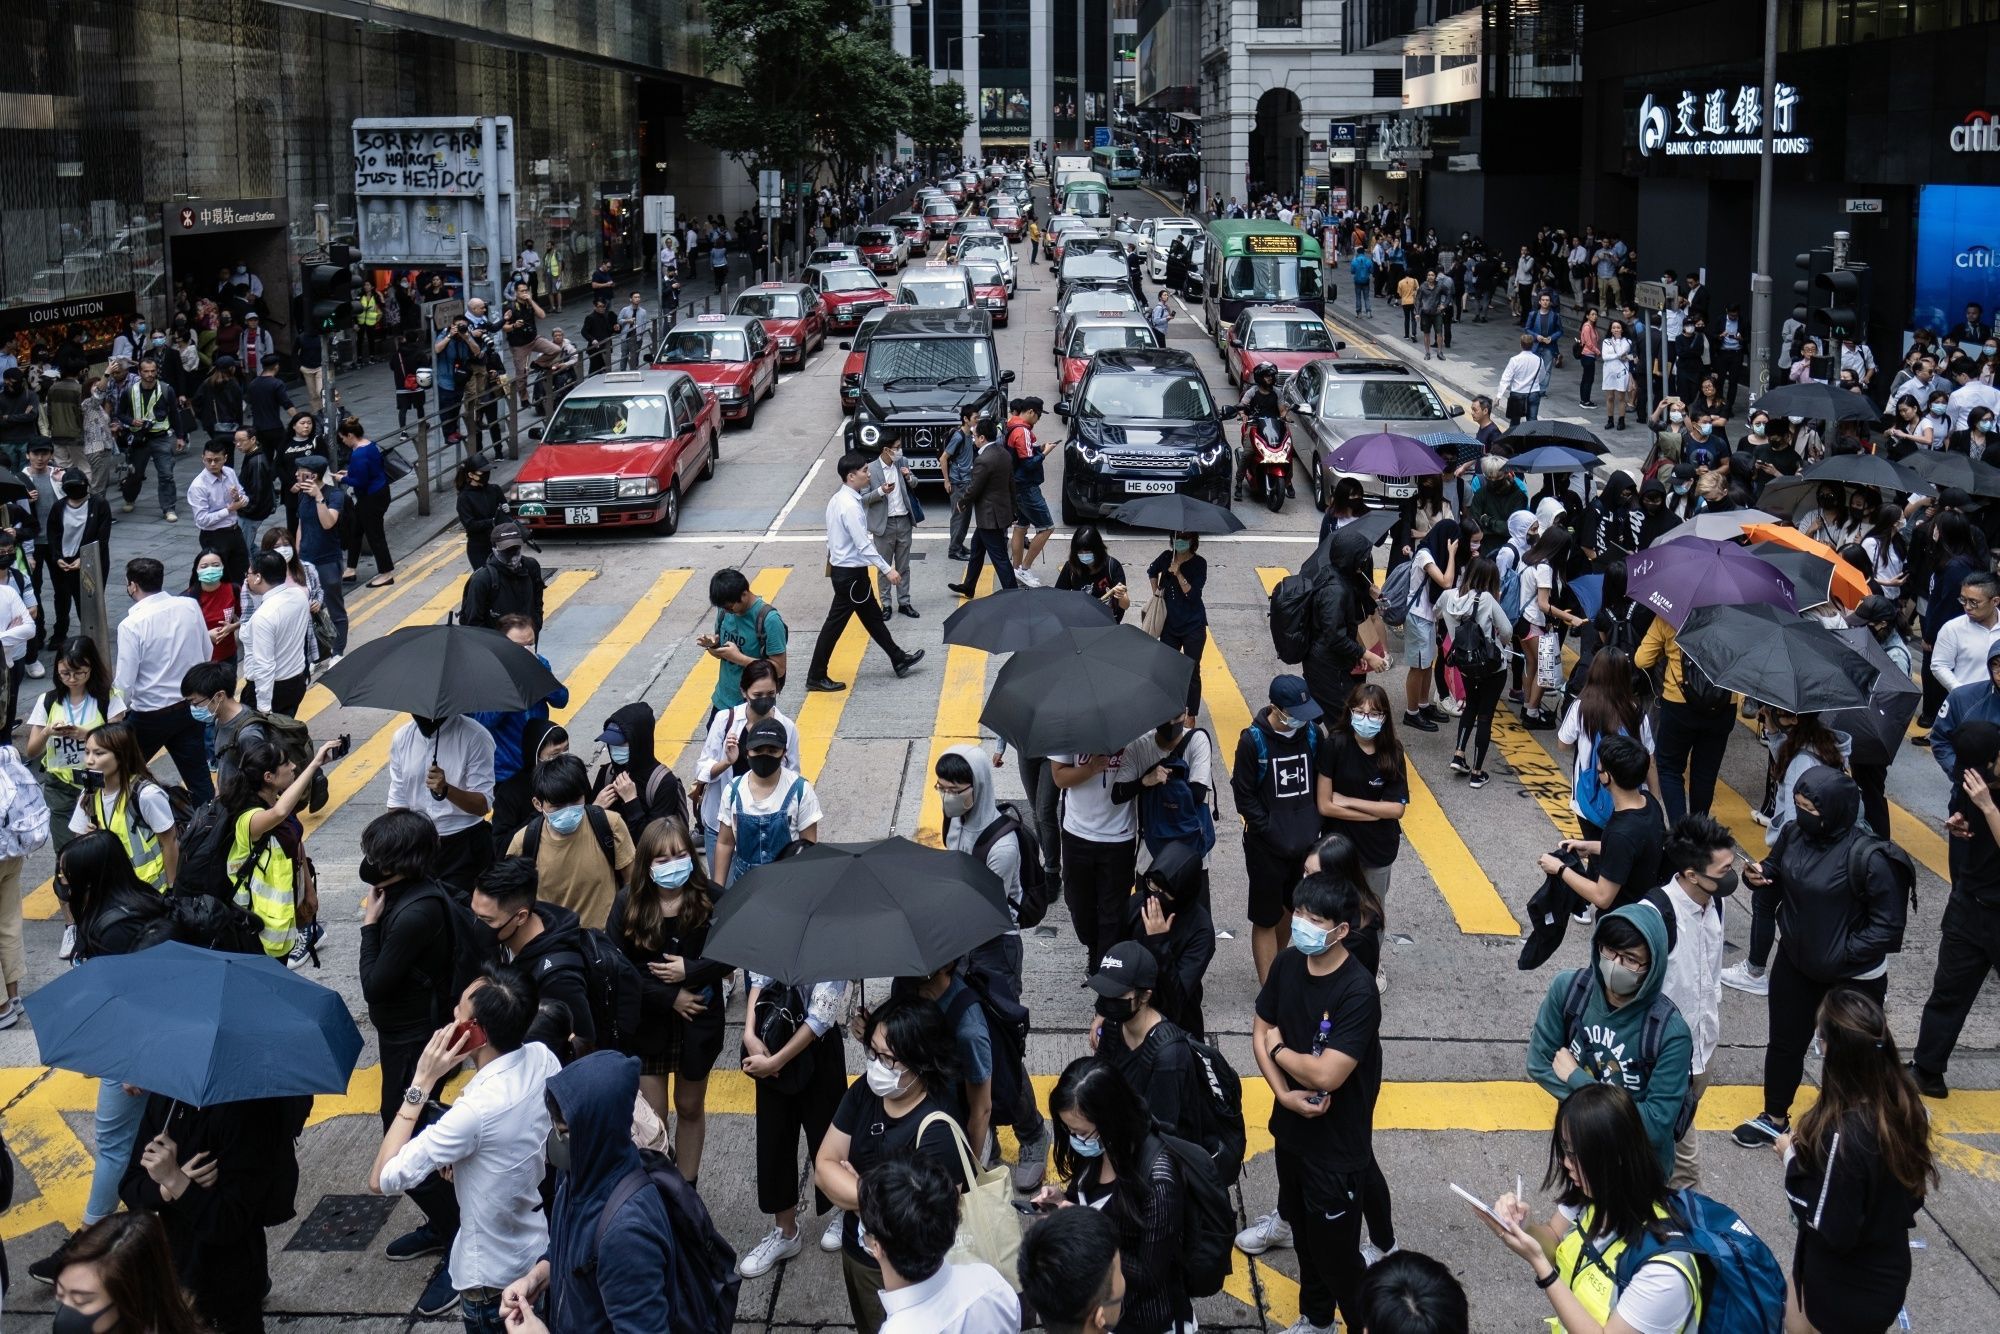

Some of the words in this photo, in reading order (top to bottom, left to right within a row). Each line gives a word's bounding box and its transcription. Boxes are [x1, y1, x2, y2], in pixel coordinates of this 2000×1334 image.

[1675, 83, 1799, 137] 交通銀行
[359, 132, 424, 154] SORRY
[1666, 142, 1690, 155] BANK
[1694, 141, 1706, 154] OF
[1709, 138, 1807, 154] COMMUNICTIONS
[403, 170, 484, 189] HEADCU
[200, 206, 234, 226] 中環站
[234, 212, 255, 223] Central
[255, 211, 276, 221] Station
[29, 307, 60, 323] LOUIS
[62, 301, 104, 317] VUITTON
[1128, 482, 1142, 491] HE
[1145, 482, 1174, 491] 6090
[1395, 488, 1409, 497] CS
[573, 515, 591, 524] 612
[574, 507, 589, 516] EC
[723, 630, 746, 647] FIND
[53, 736, 86, 755] PRE
